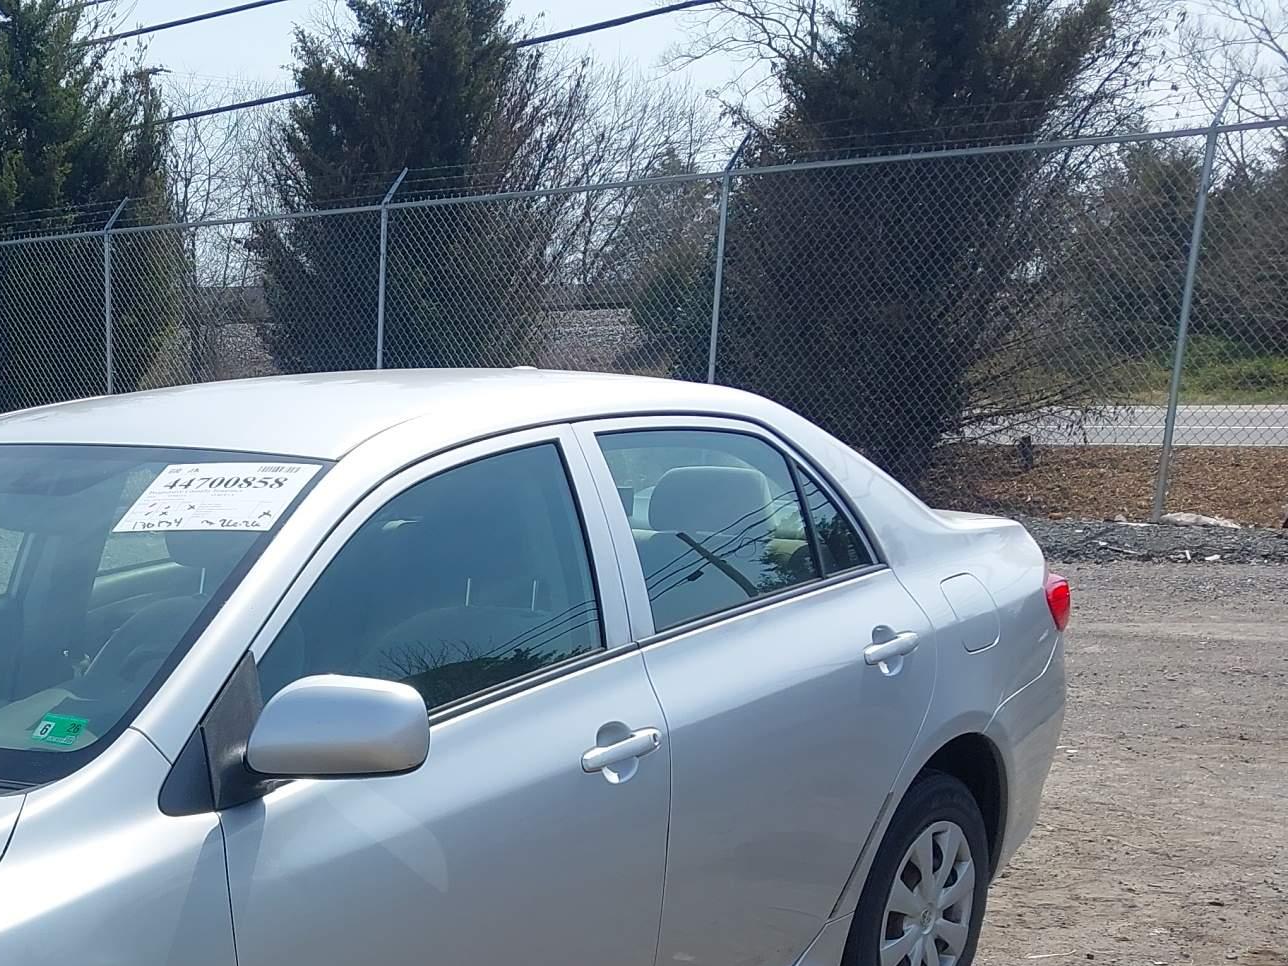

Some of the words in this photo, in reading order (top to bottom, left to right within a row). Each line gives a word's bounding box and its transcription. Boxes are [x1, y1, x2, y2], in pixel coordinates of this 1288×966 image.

[163, 476, 289, 490] 44700858
[39, 723, 52, 736] 6
[66, 722, 82, 735] 26
